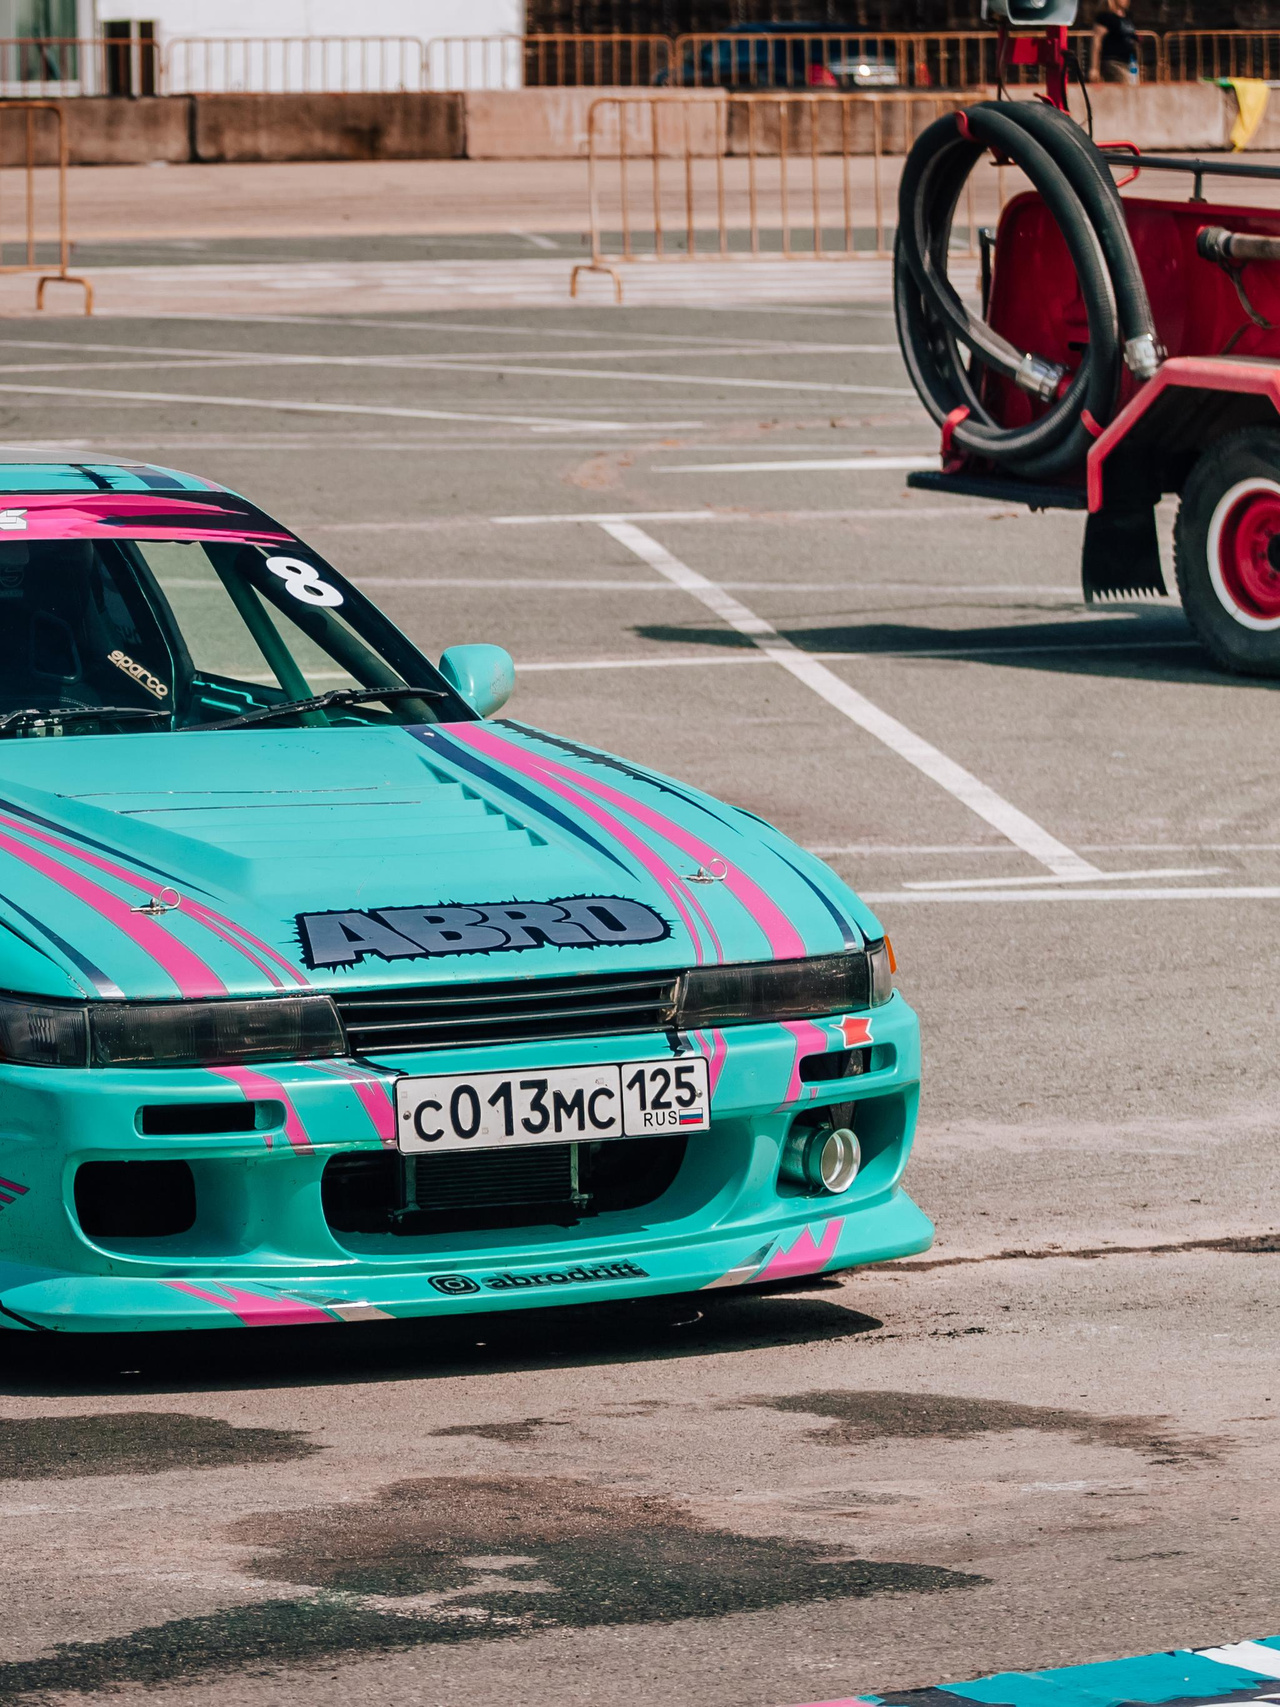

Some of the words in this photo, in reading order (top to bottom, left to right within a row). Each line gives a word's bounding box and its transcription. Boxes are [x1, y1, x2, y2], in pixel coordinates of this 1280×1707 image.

[265, 556, 344, 607] 8
[108, 650, 169, 699] sparco
[302, 896, 664, 964] ABRO
[626, 1065, 696, 1111] 125
[643, 1110, 677, 1127] RUS
[485, 1262, 640, 1289] abrodrift
